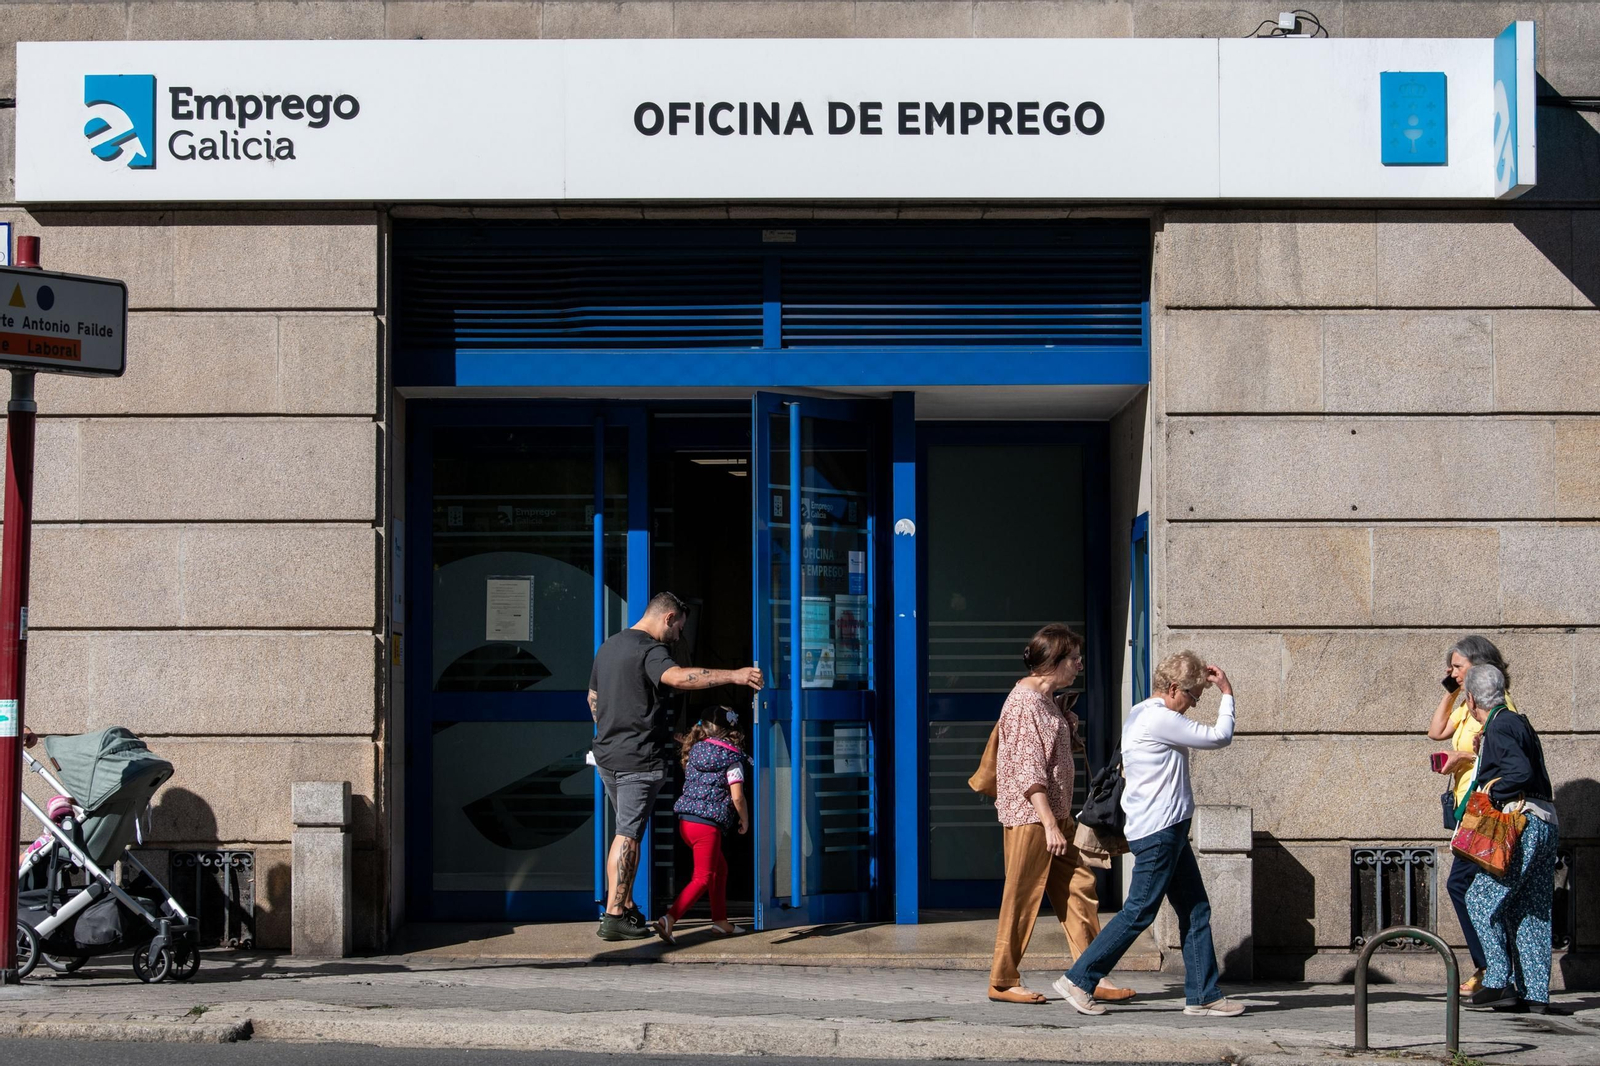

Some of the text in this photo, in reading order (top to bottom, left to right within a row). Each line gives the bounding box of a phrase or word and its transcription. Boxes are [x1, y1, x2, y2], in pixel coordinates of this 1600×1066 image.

[168, 87, 360, 128] Emprego
[633, 101, 1105, 136] OFICINA DE EMPREGO
[168, 130, 296, 161] Galicia
[0, 314, 113, 337] te Antonio Failde
[28, 339, 78, 358] Laboral
[516, 508, 556, 518] Emprego
[811, 501, 834, 512] Emprego
[811, 511, 826, 519] Galicia
[803, 548, 834, 560] OFICINA
[807, 565, 843, 577] EMPREGO
